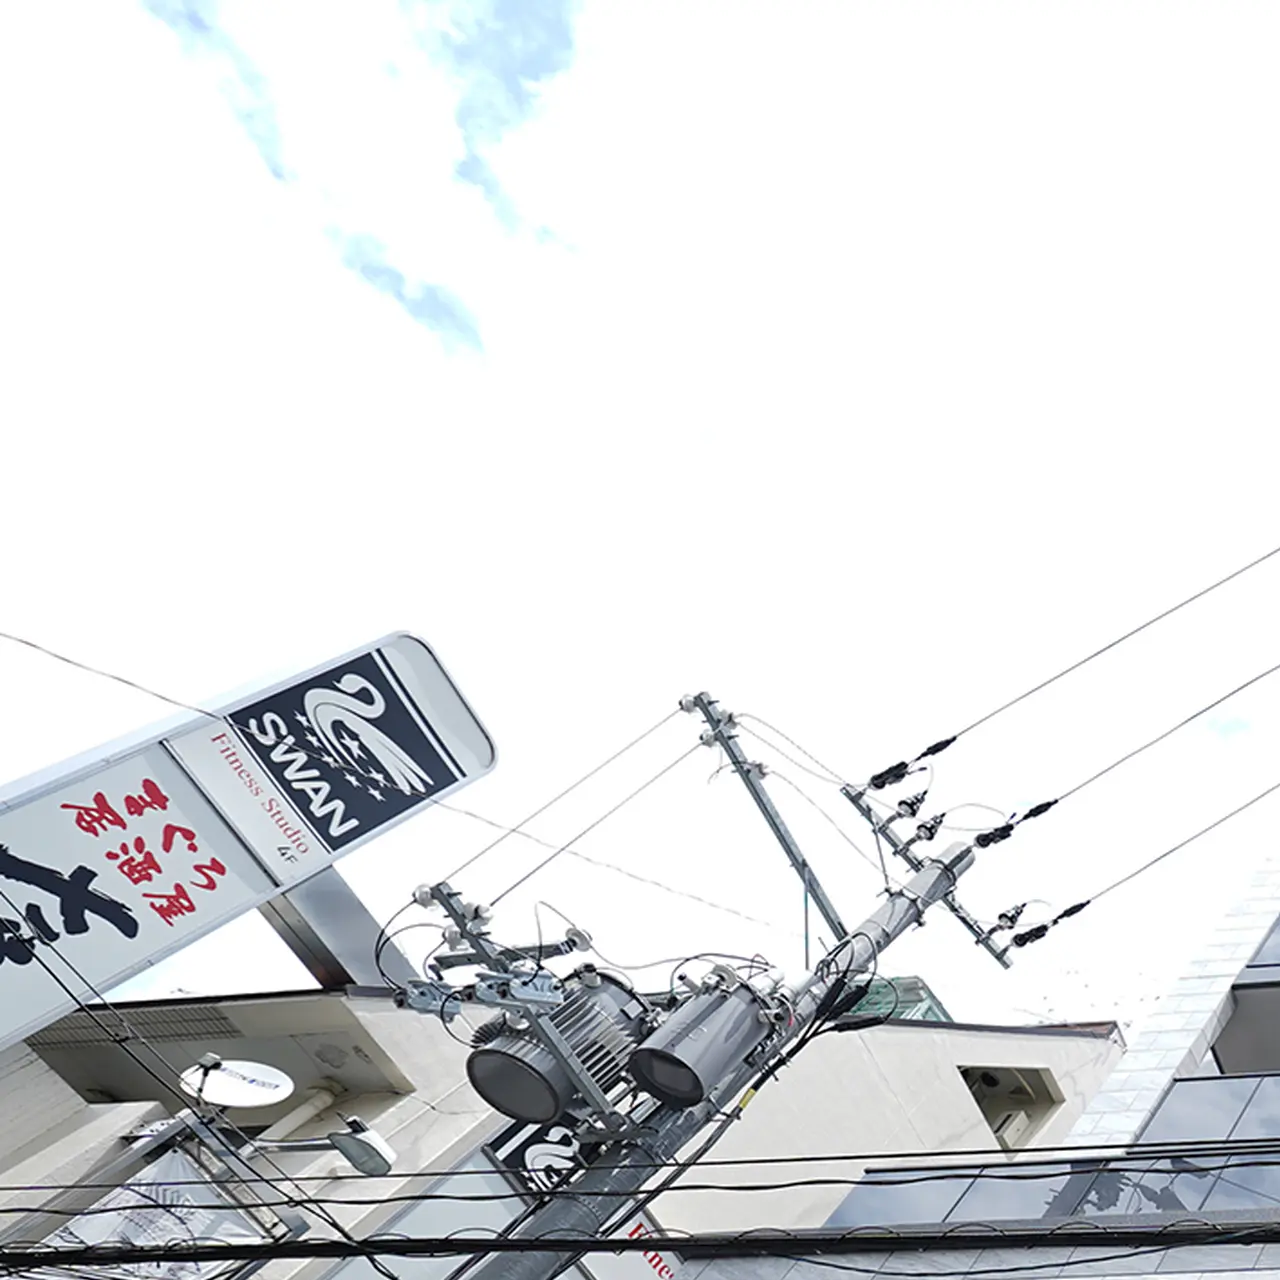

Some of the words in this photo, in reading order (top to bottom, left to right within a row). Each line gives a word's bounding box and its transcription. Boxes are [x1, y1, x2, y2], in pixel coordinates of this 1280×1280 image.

[124, 778, 226, 891] まぐろ
[211, 733, 264, 797] Fitness
[261, 797, 309, 854] Studio
[249, 712, 360, 837] SWAN
[60, 792, 196, 926] 居酒屋
[277, 844, 299, 865] 4F
